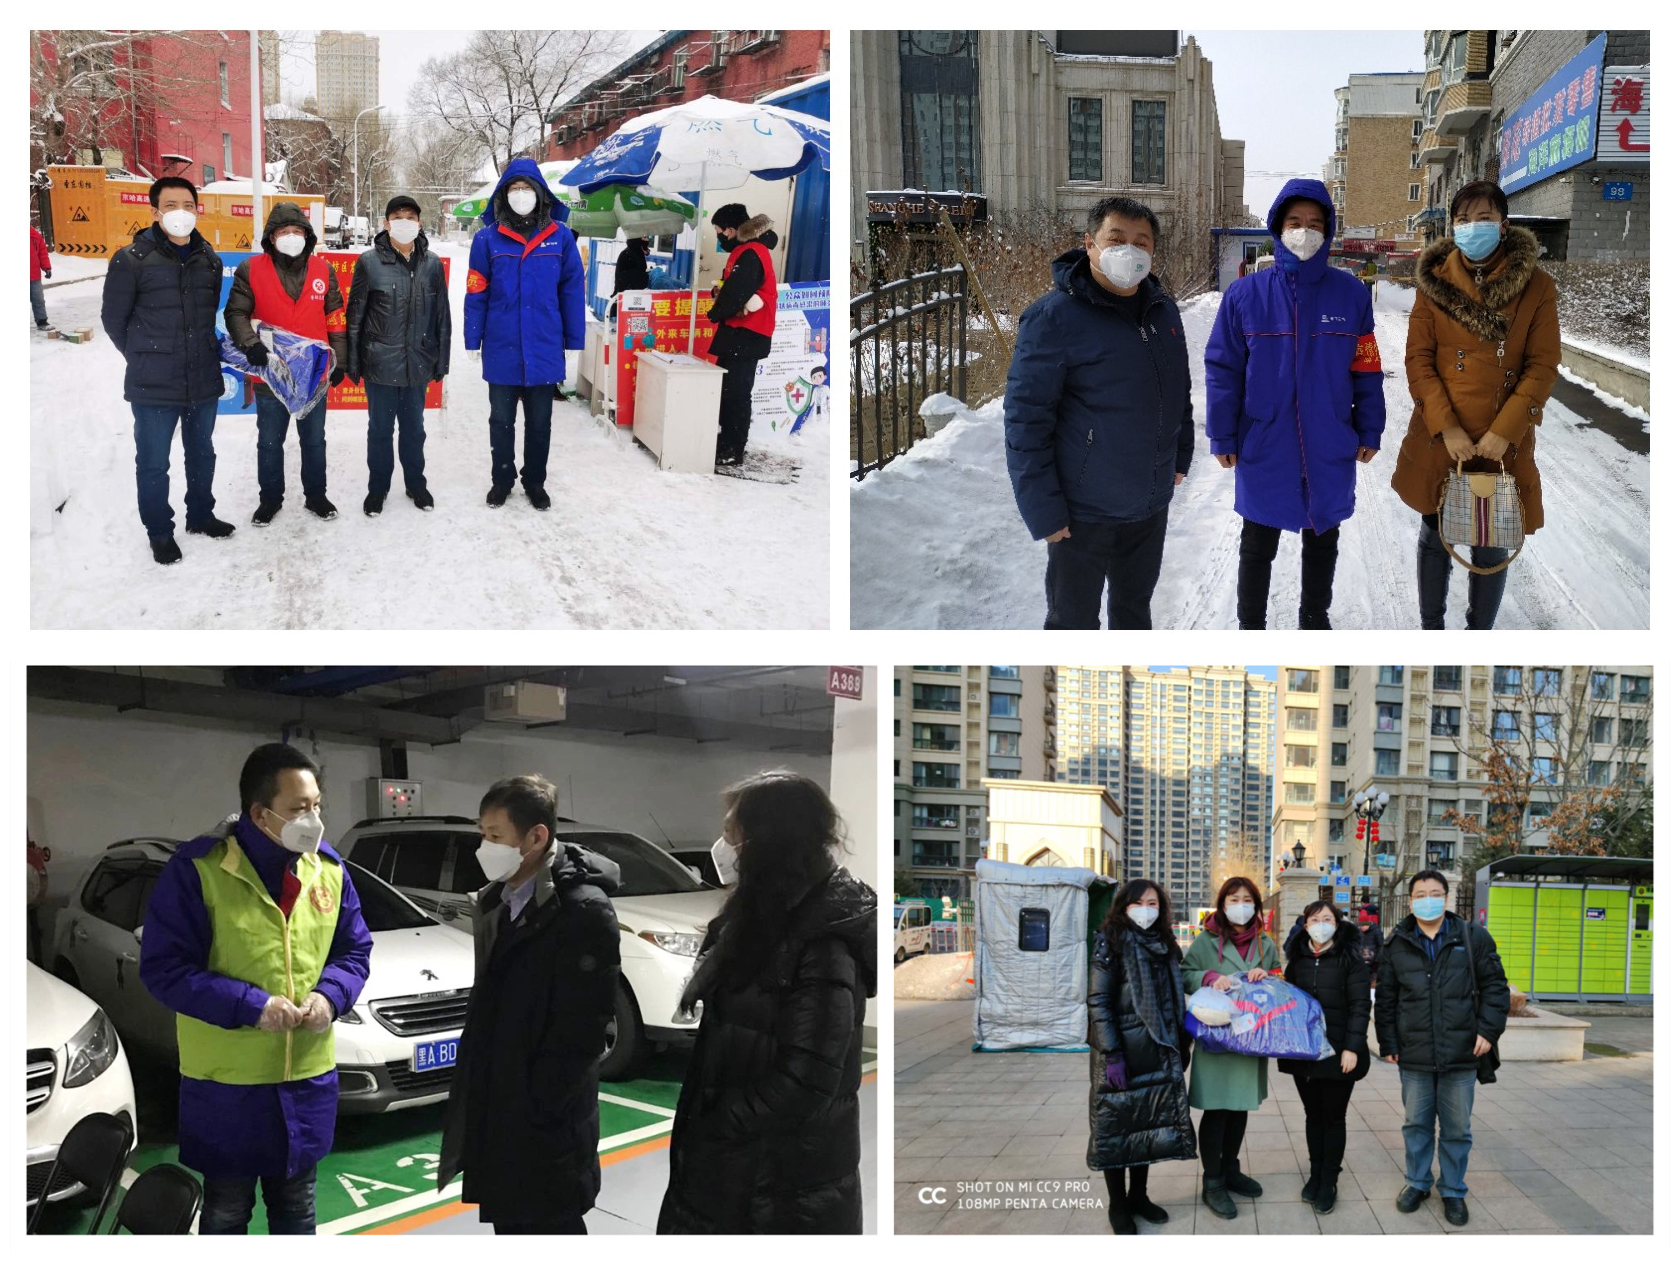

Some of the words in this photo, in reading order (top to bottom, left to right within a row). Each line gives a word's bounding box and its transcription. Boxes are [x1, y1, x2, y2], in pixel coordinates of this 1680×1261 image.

[1610, 187, 1625, 196] 98
[232, 206, 254, 216] 京哈高
